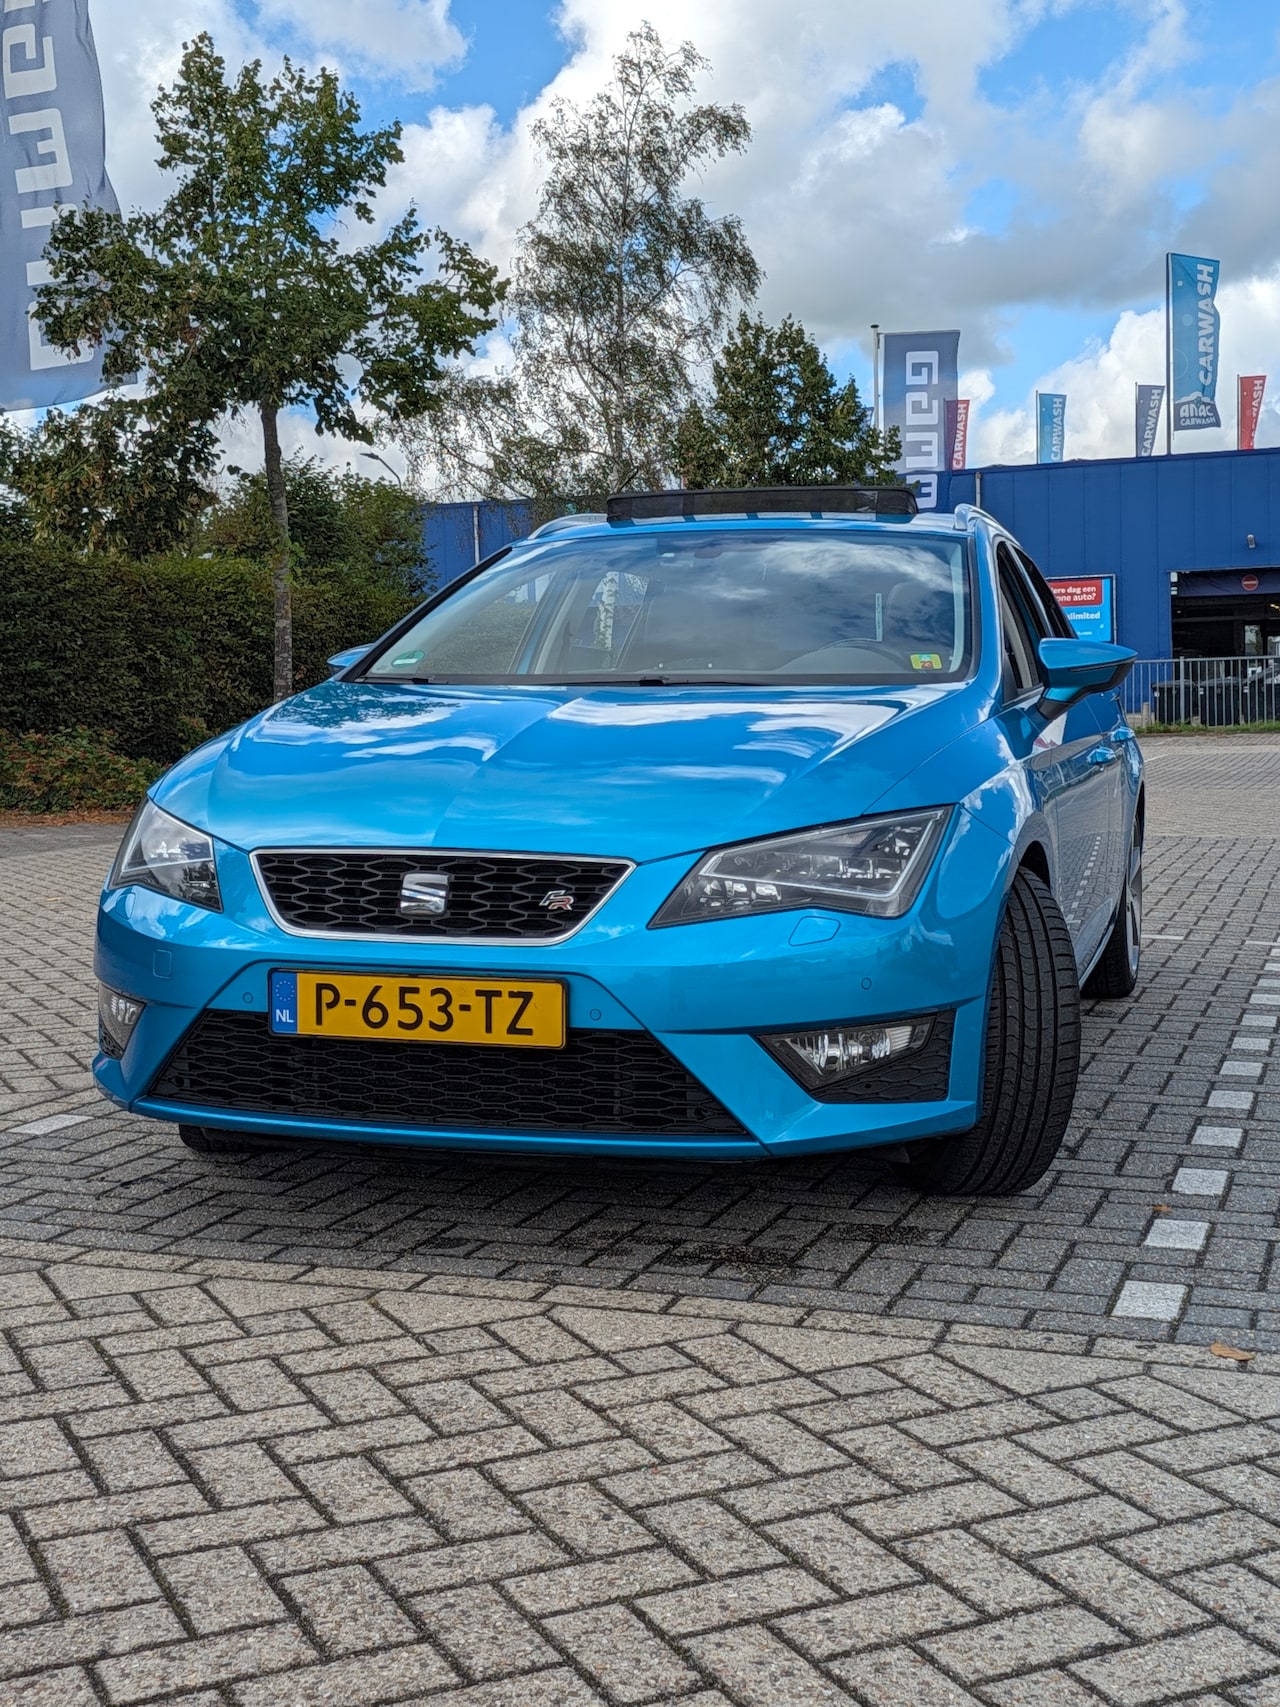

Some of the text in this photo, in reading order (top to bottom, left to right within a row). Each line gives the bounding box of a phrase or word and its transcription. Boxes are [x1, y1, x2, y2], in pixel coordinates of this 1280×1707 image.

[1197, 264, 1215, 386] CARWASH
[905, 351, 939, 509] GAMM
[952, 404, 967, 469] CARWASH
[1050, 397, 1063, 461] CARWASH
[1141, 389, 1161, 456] CARWASH
[1180, 416, 1216, 426] CARWASH
[1067, 586, 1081, 594] dag
[539, 890, 575, 910] FR
[275, 1009, 295, 1023] NL
[314, 983, 534, 1035] P-653-TZ
